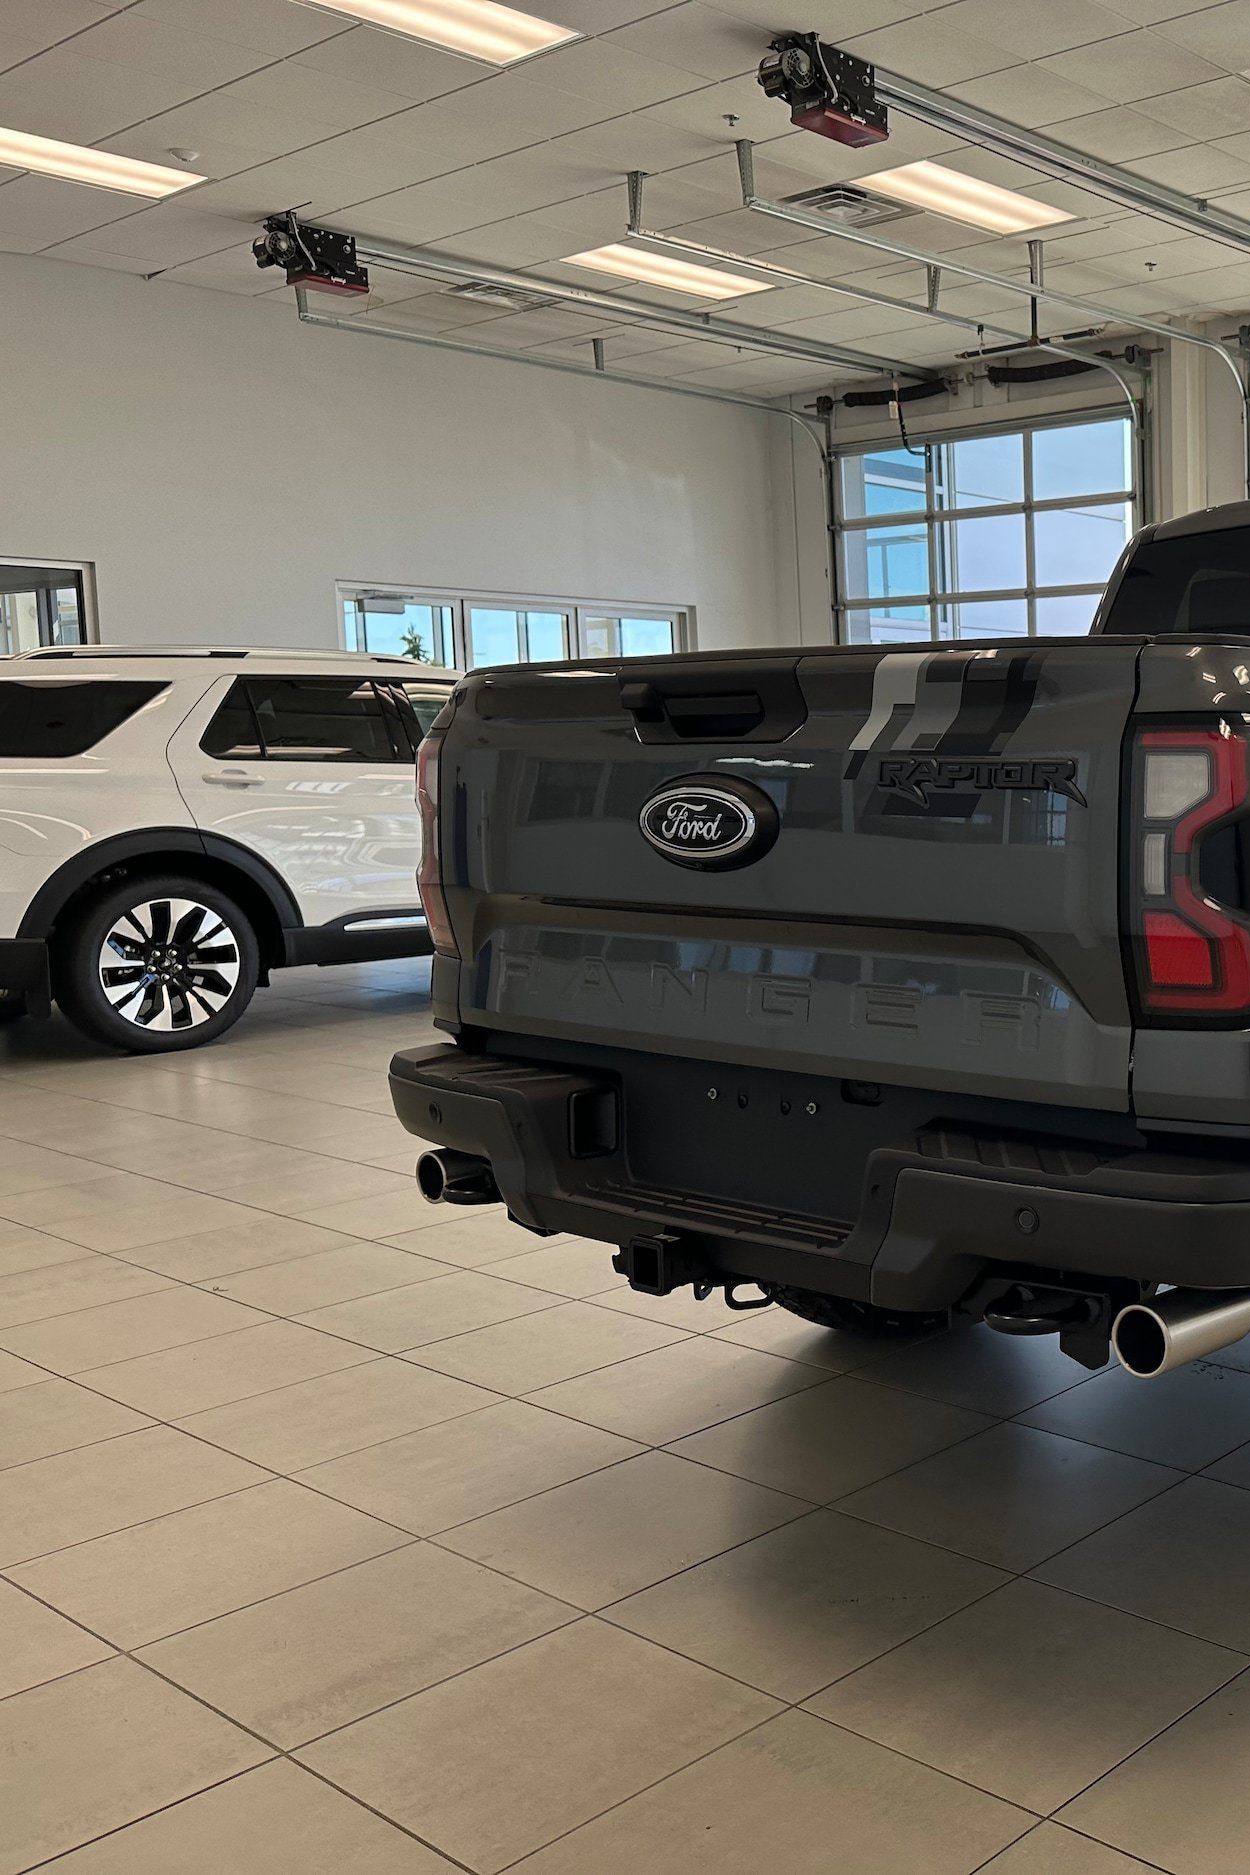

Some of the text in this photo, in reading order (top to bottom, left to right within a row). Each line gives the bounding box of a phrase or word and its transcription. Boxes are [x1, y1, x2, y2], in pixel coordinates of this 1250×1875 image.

[878, 757, 1088, 809] RAPTOR
[661, 801, 722, 841] Ford
[497, 948, 1043, 1053] RANGER
